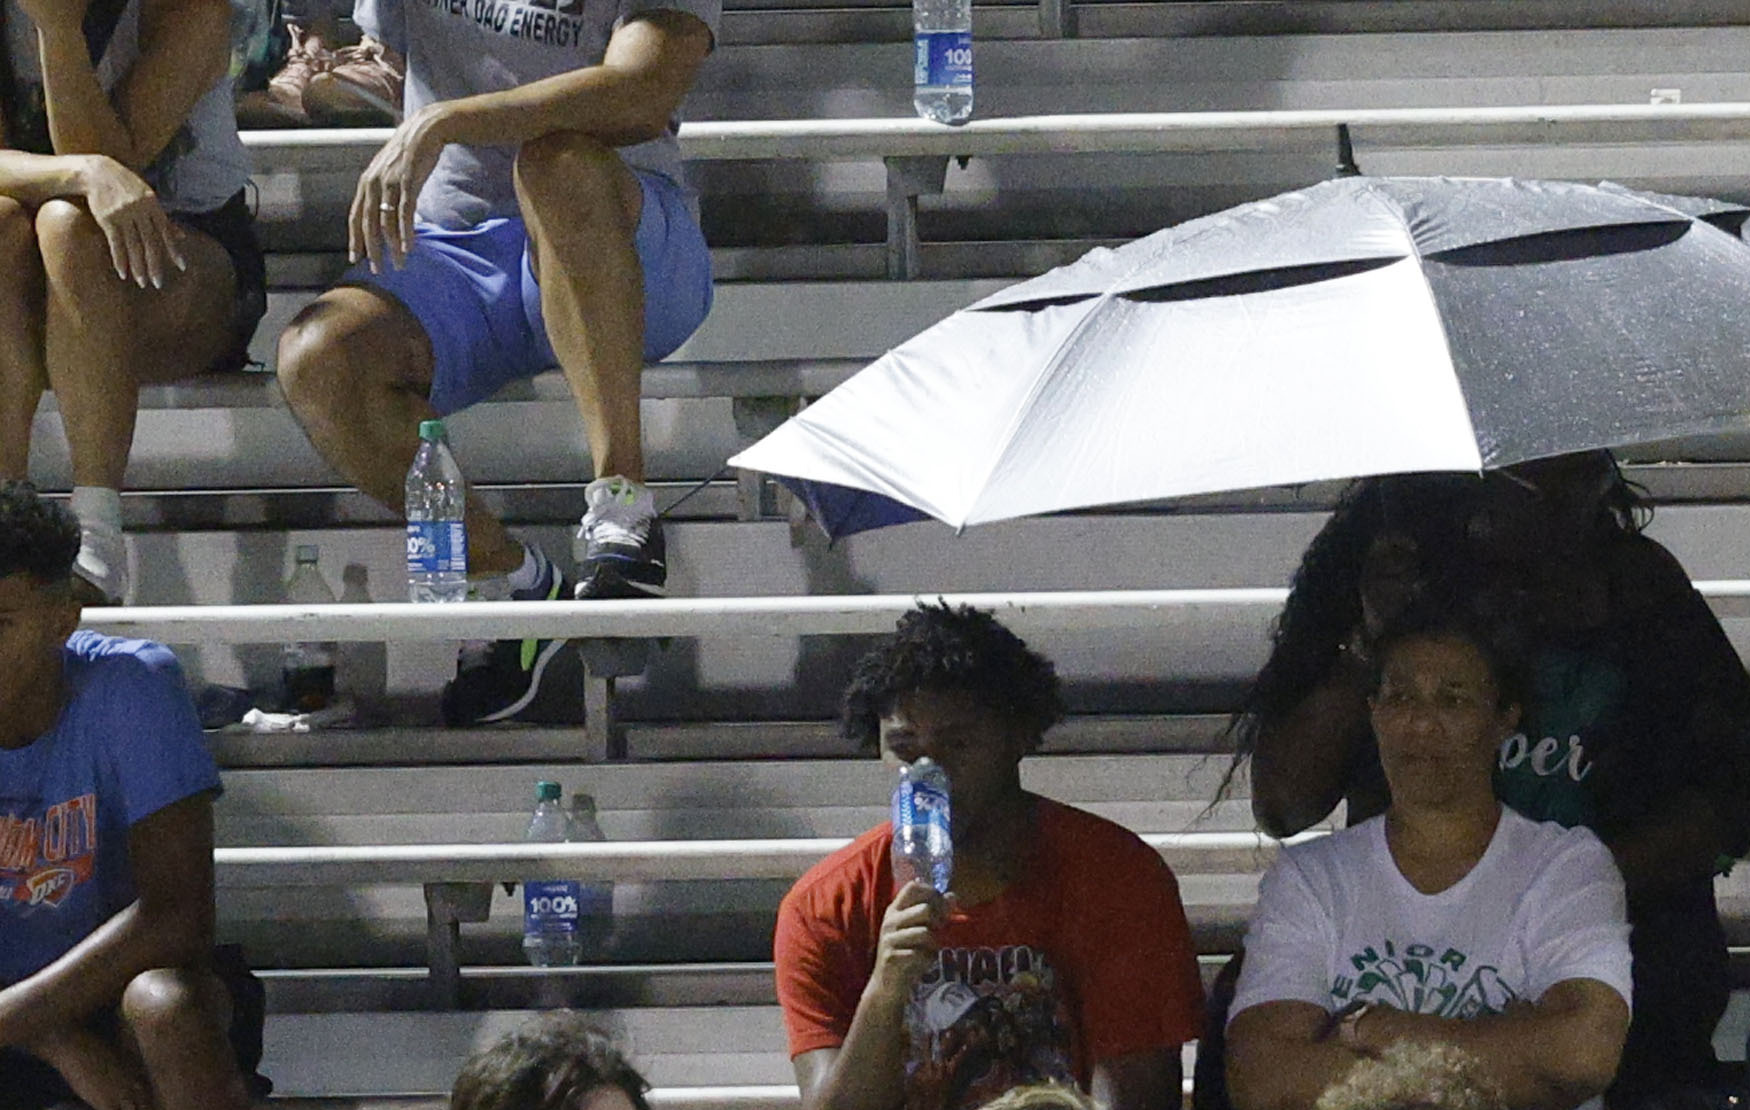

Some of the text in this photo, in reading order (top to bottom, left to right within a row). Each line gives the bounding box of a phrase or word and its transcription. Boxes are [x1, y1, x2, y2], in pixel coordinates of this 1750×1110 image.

[510, 10, 585, 48] ENERGY
[530, 895, 578, 914] 100%
[1330, 938, 1467, 1000] ENIOR
